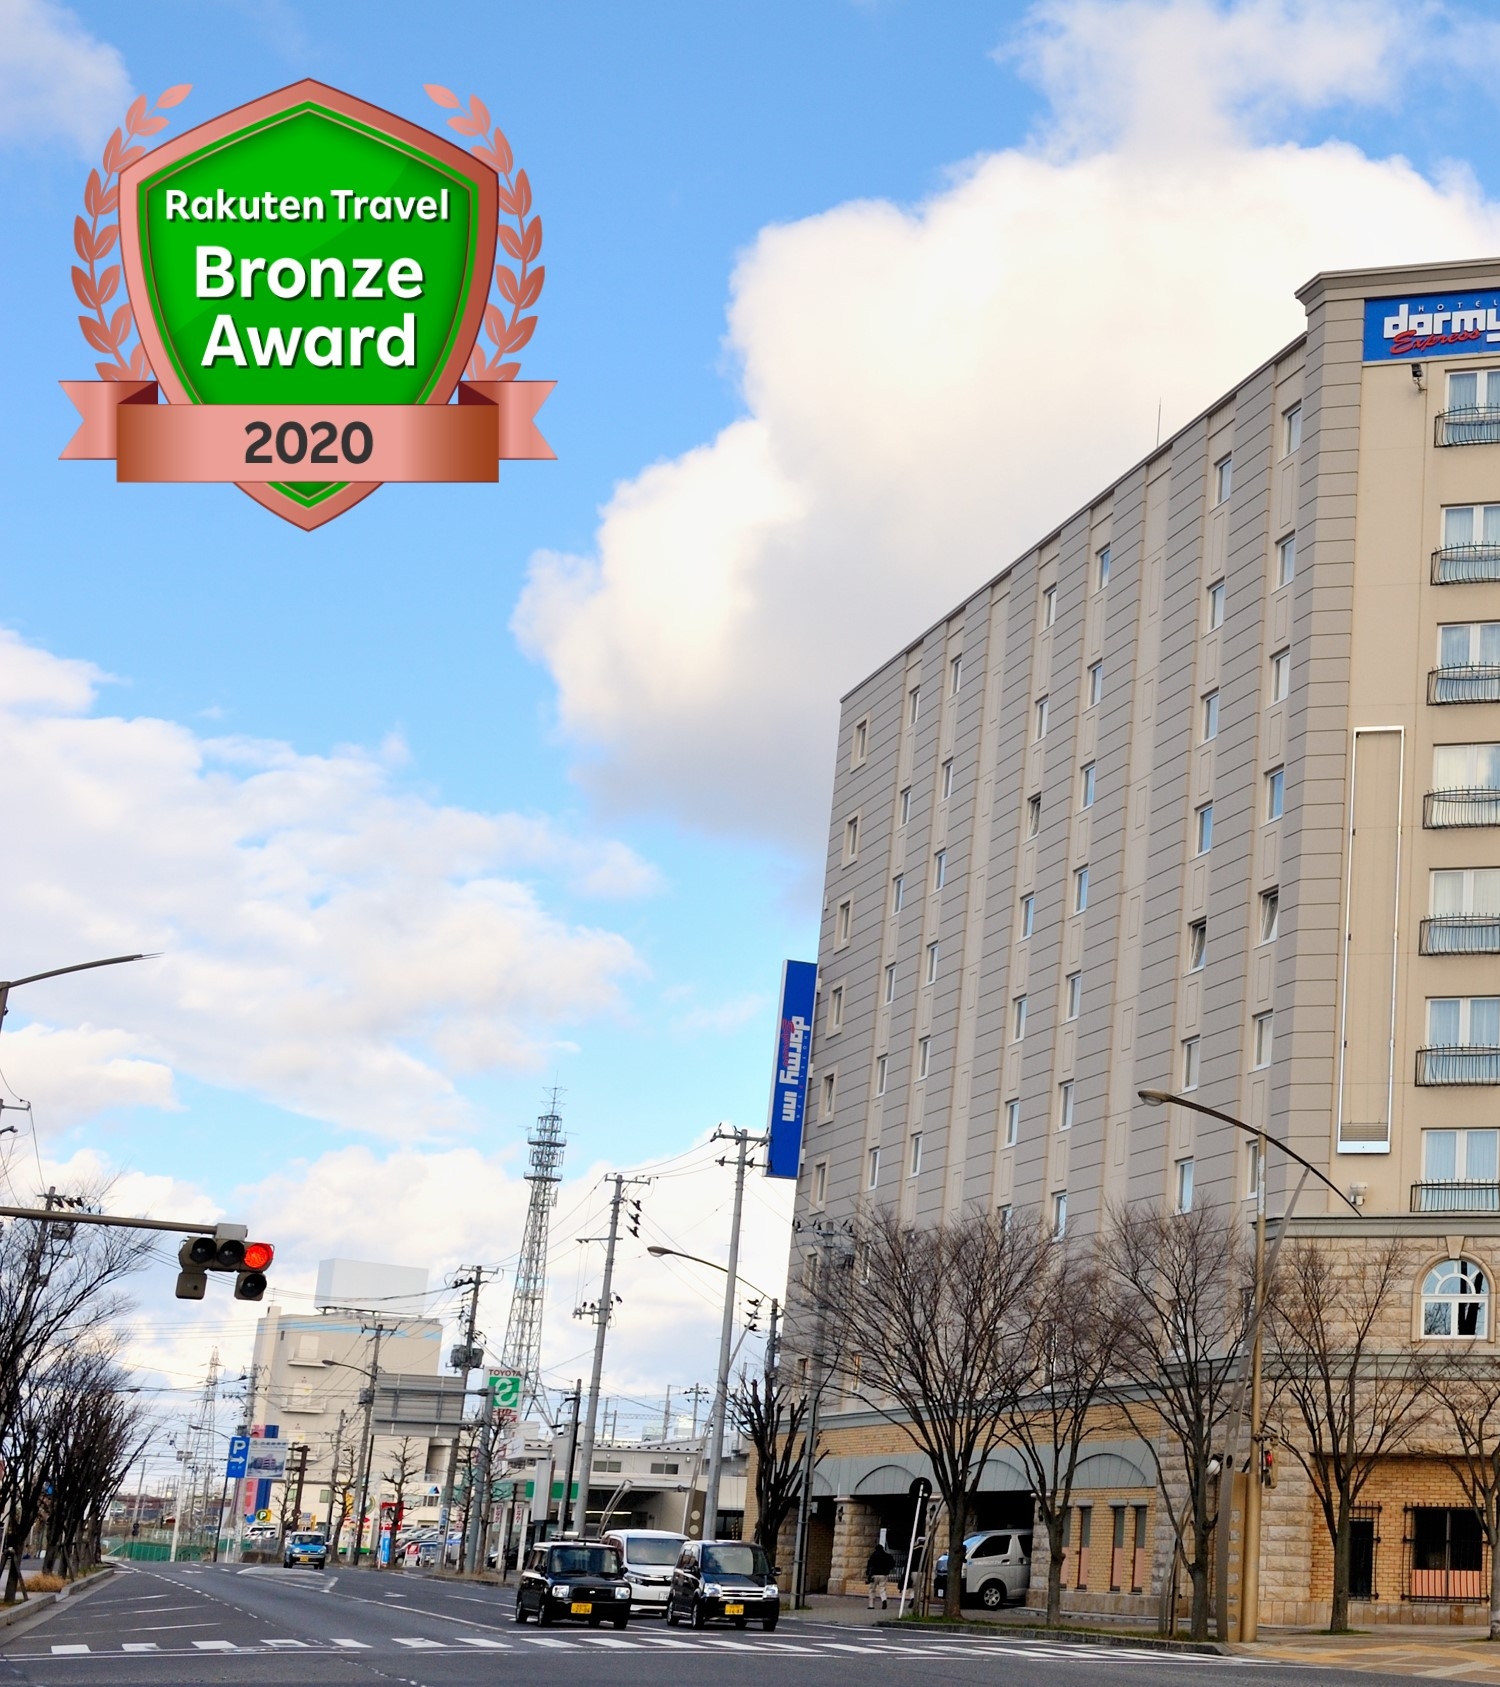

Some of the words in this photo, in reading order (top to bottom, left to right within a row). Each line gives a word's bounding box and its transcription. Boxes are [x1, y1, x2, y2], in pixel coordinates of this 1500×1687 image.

[1419, 299, 1498, 312] HOTEL
[1391, 329, 1481, 354] Express
[779, 1016, 811, 1085] dormy
[782, 1091, 797, 1122] inn
[489, 1369, 522, 1377] TOYOTA
[232, 1440, 247, 1455] P
